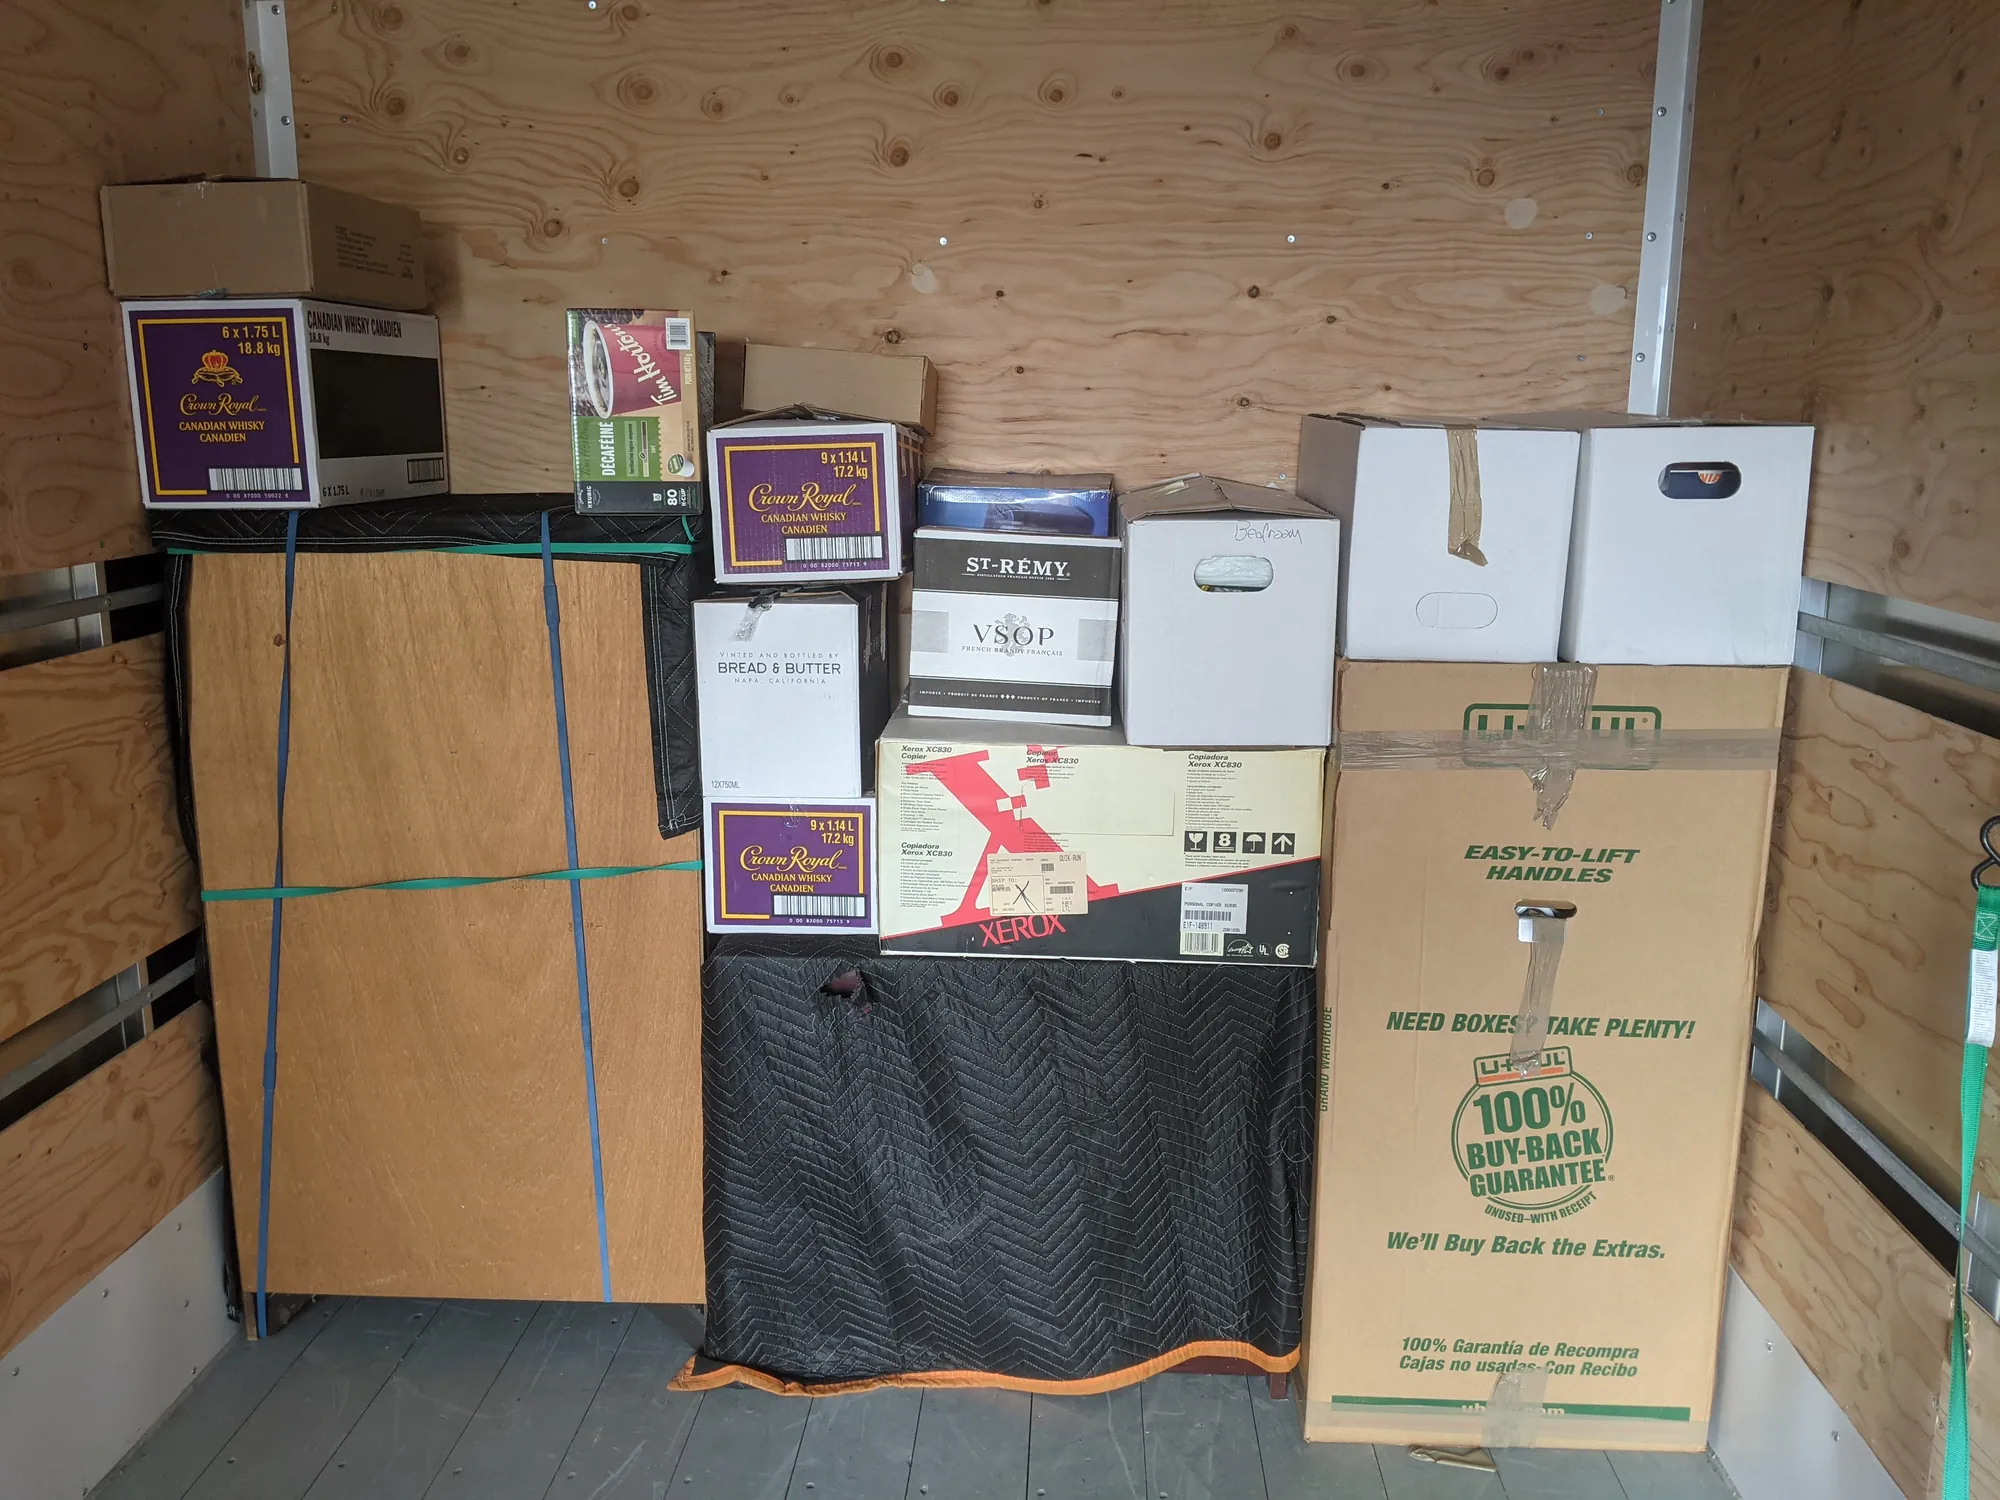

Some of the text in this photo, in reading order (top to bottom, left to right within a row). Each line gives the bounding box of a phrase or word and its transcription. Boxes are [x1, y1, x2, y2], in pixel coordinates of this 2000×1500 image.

[222, 325, 280, 339] 6 x 1.75 L
[307, 310, 402, 338] CANADIAN WHISKY CANADIEN
[309, 332, 330, 346] 18.8 kg
[238, 341, 281, 356] 18.8 kg
[604, 323, 678, 405] Tim Hortons
[684, 371, 693, 385] POIDS
[180, 392, 260, 416] Crown Royal
[178, 421, 265, 431] CANADIAN WHISKY
[199, 433, 246, 443] CANADIEN
[599, 421, 616, 476] DÉCAFÉINÉ
[821, 451, 867, 464] 9 x 1.14 L
[834, 465, 868, 480] 17.2 kg
[322, 487, 327, 497] 6
[333, 485, 345, 496] 1.75
[667, 488, 678, 506] 80
[748, 482, 857, 512] Crown Royal
[761, 512, 847, 523] CANADIAN WHISKY
[781, 525, 828, 534] CANADIEN
[966, 557, 1069, 577] ST-RÉMY
[973, 624, 1054, 646] VSOP
[1026, 649, 1063, 657] FRANÇAIS
[718, 662, 841, 675] BREAD & BUTTER
[901, 745, 924, 753] Xerox
[1188, 753, 1229, 761] Copiadora
[1188, 760, 1212, 768] Xerox
[711, 780, 740, 789] 12X750ML
[810, 820, 854, 831] 9 x 1.14 L
[821, 833, 854, 846] 17.2 kg
[740, 845, 843, 873] Crown Royal
[1464, 845, 1640, 864] EASY-TO-LIFT
[751, 873, 832, 883] CANADIAN WHISKY
[1486, 865, 1613, 884] HANDLES
[769, 884, 814, 893] CANADIEN
[978, 914, 1067, 947] XEROX
[1387, 1012, 1445, 1032] NEED
[1546, 1016, 1600, 1037] TAKE
[1604, 1018, 1696, 1040] PLENTY!
[1319, 1006, 1332, 1112] GRAND WARDROBE
[1473, 1082, 1587, 1136] 100%
[1466, 1127, 1603, 1170] BUY-BACK
[1469, 1158, 1607, 1198] GUARANTEE
[1559, 1191, 1598, 1218] RECEIPT
[1387, 1231, 1665, 1259] We'll Buy Back the Extras.
[1402, 1337, 1640, 1361] 100% Garantía de Recompra
[1399, 1355, 1445, 1373] Cajas
[1449, 1360, 1471, 1372] no
[1579, 1361, 1638, 1378] Recibo
